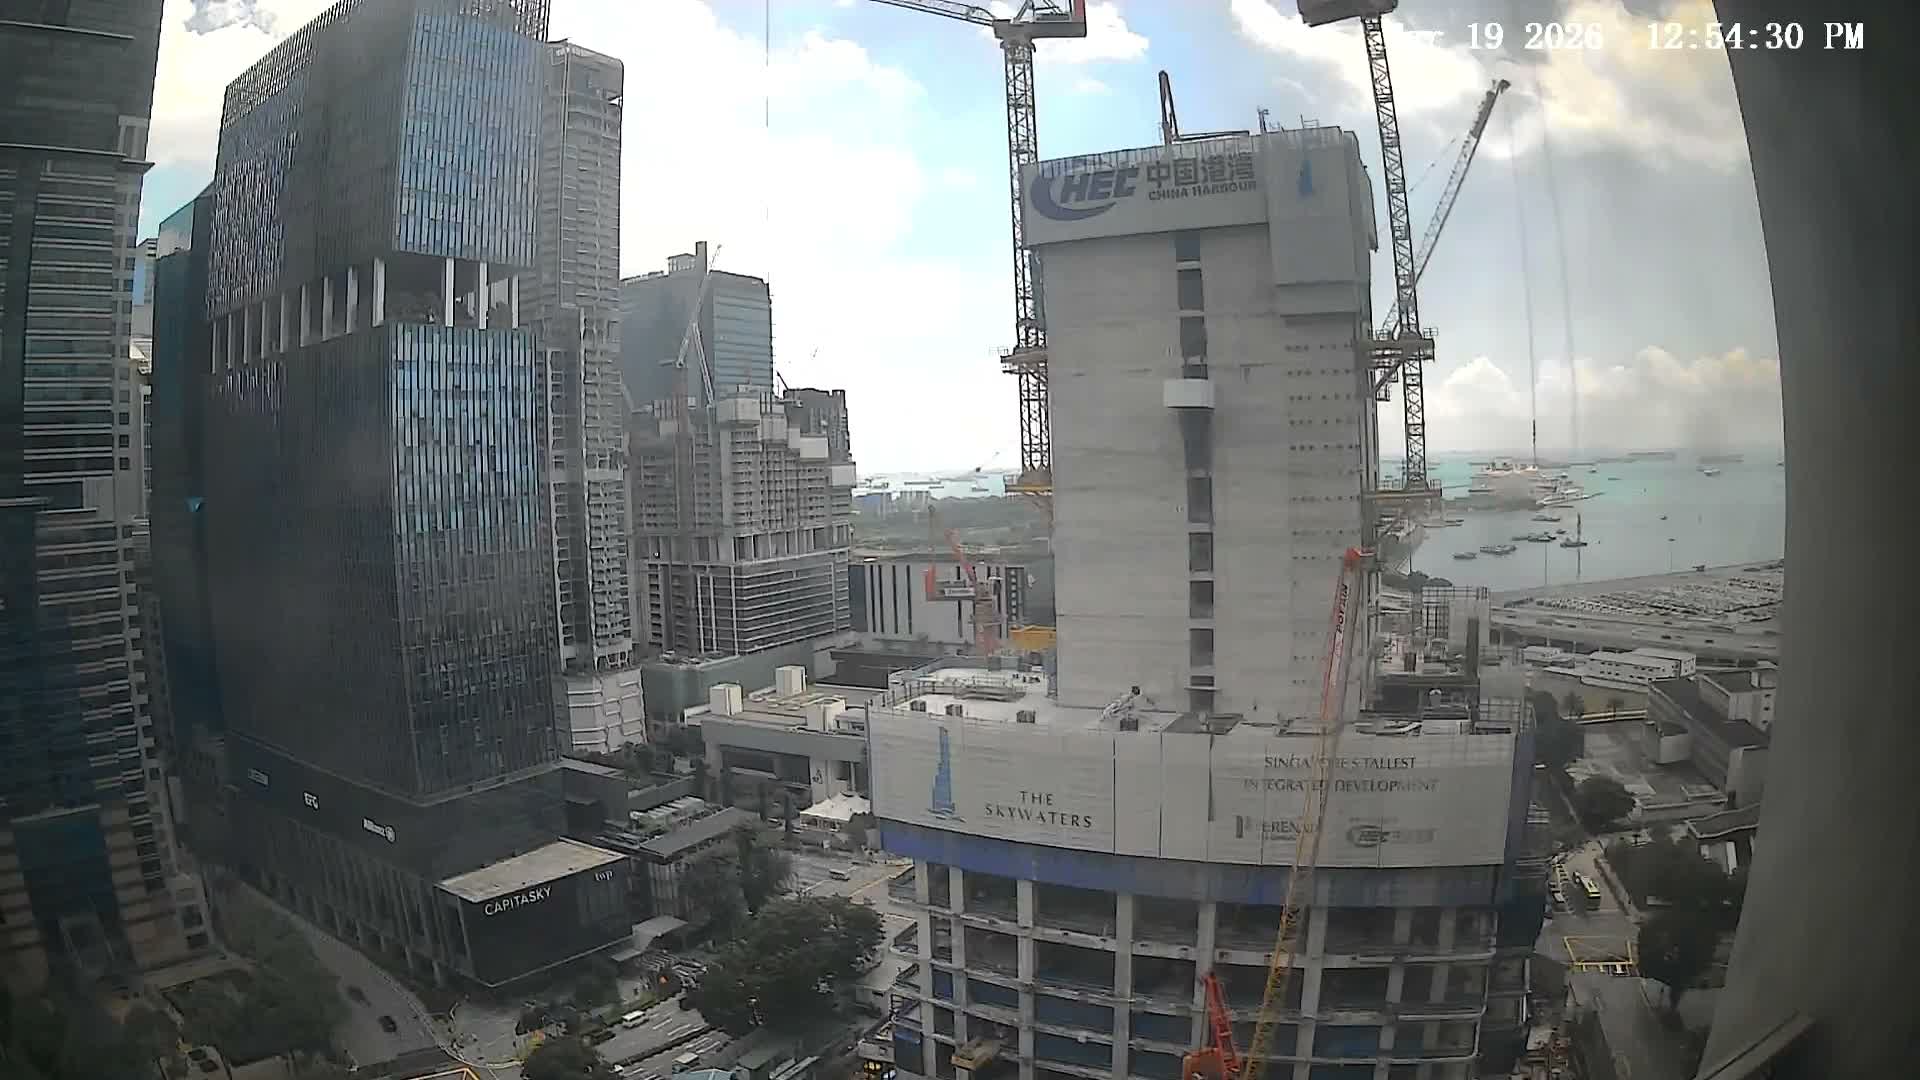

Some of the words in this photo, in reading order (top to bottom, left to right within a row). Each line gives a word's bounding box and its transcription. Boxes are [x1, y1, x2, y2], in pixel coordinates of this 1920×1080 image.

[1148, 188, 1189, 201] CHINA
[1363, 756, 1416, 769] TALLEST
[1020, 790, 1053, 806] THE
[985, 803, 1092, 827] SKYWATERS
[484, 887, 552, 915] CAPITASKY
